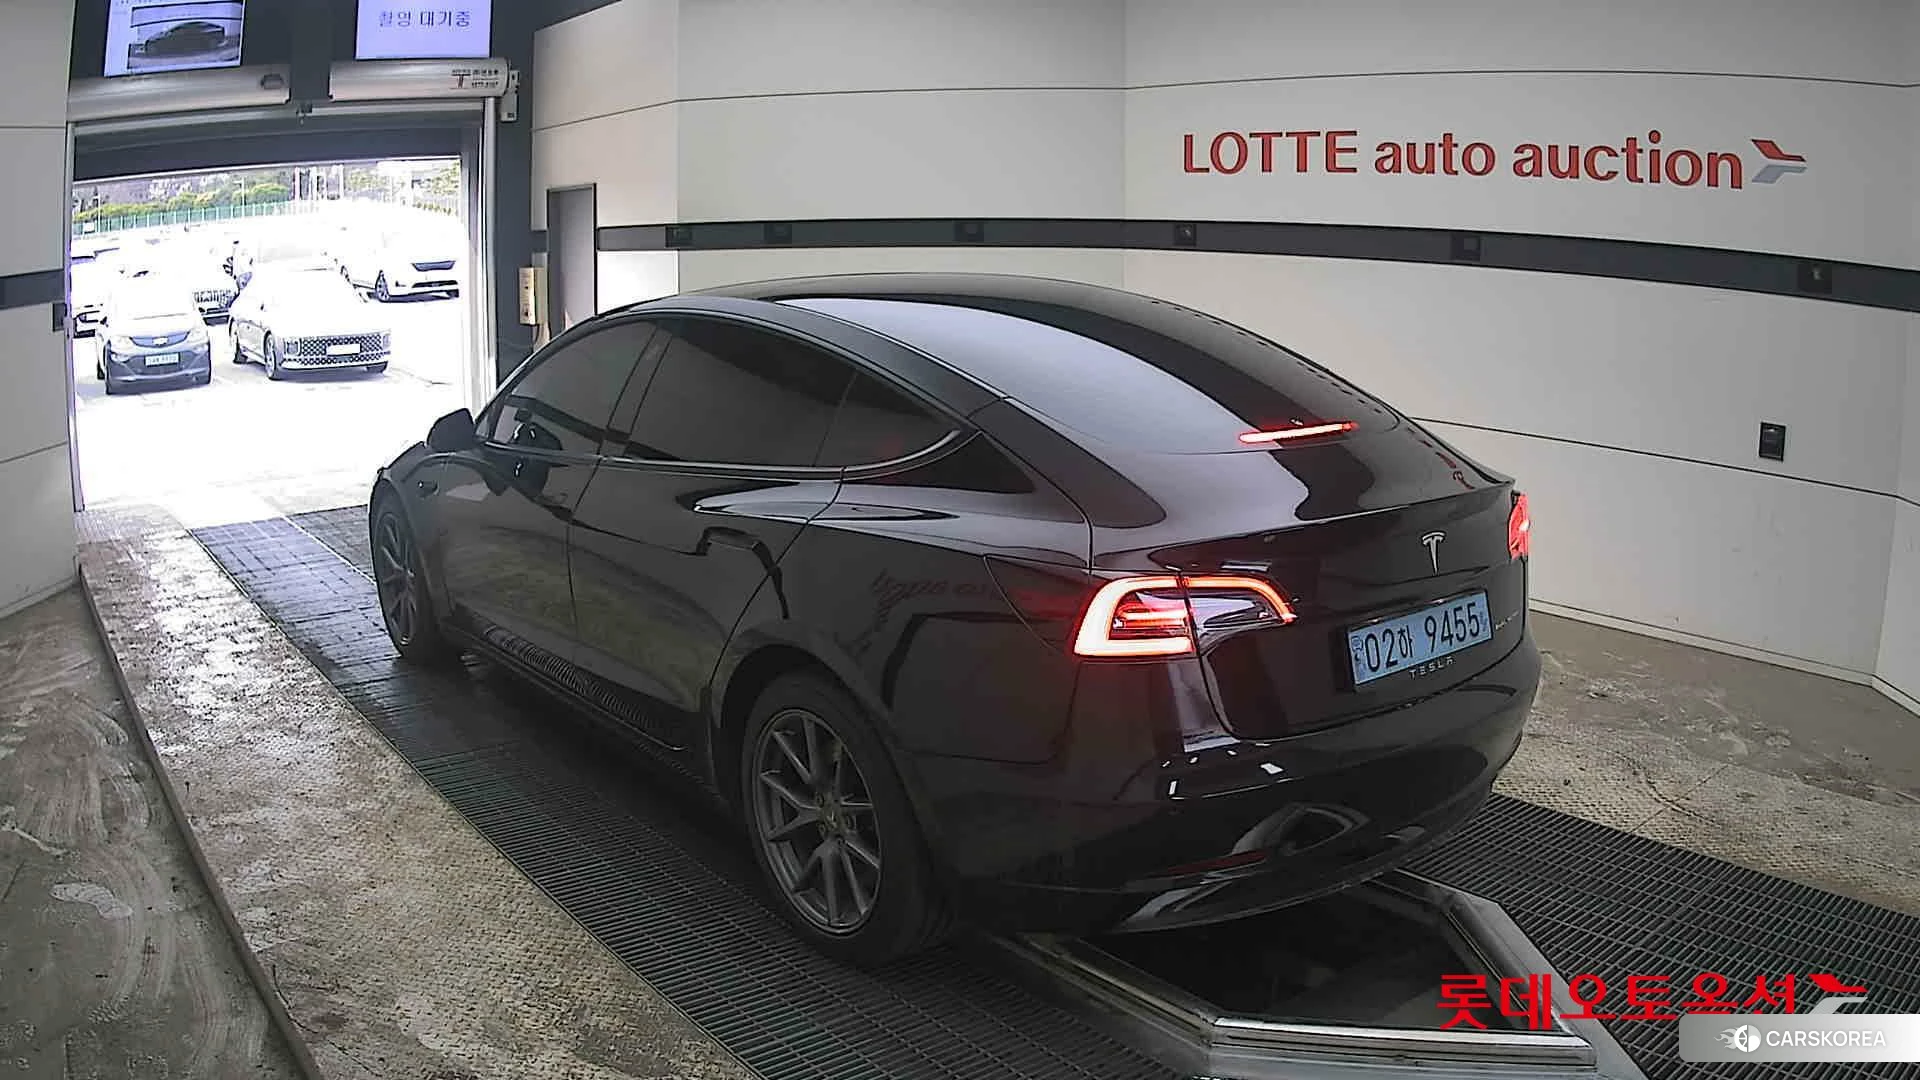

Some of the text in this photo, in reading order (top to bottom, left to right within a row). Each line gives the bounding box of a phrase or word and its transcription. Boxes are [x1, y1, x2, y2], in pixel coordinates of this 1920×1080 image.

[420, 11, 470, 27] 대기중
[1183, 129, 1743, 189] LOTTE auto auction
[1364, 625, 1413, 672] 02하
[1425, 602, 1480, 653] 9455
[1409, 656, 1456, 680] TESLA
